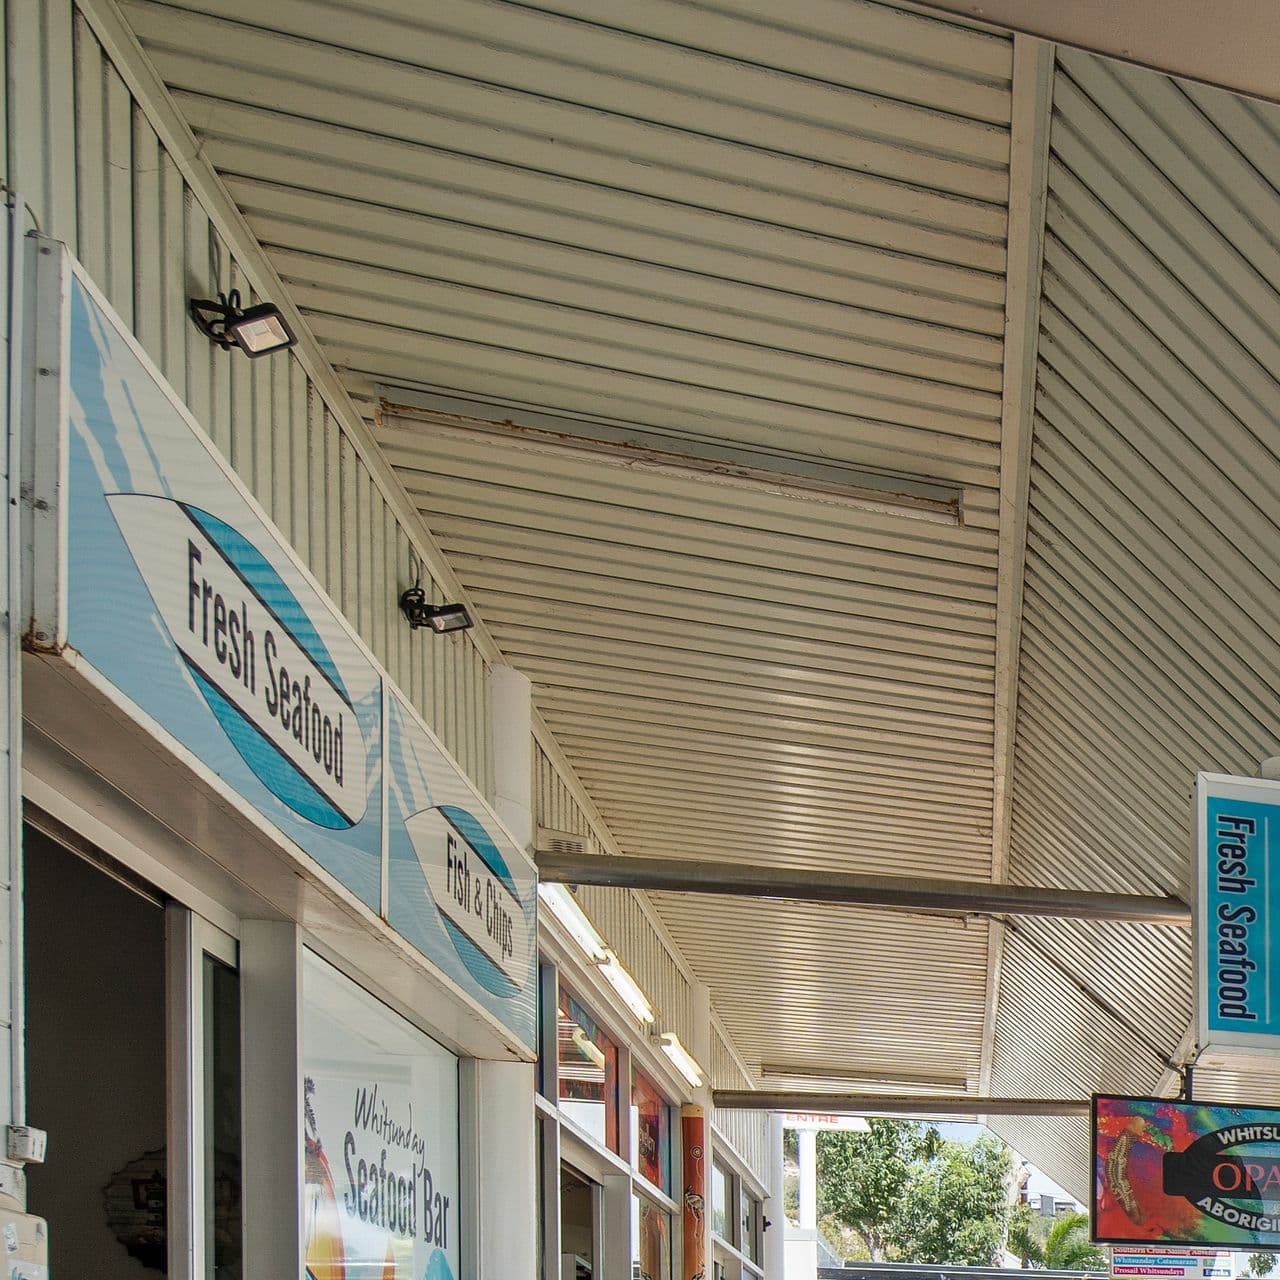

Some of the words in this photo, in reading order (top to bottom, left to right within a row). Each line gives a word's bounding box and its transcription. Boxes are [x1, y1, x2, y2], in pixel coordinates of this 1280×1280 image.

[187, 538, 256, 696] Fresh
[264, 630, 344, 788] Seafood
[446, 831, 471, 914] Fish
[474, 877, 483, 920] &
[486, 878, 514, 963] Chips
[1217, 814, 1257, 895] Fresh
[1217, 903, 1257, 1022] Seafood
[354, 1083, 426, 1178] Whitsunday
[344, 1131, 417, 1239] Seafood
[423, 1167, 450, 1250] Bar
